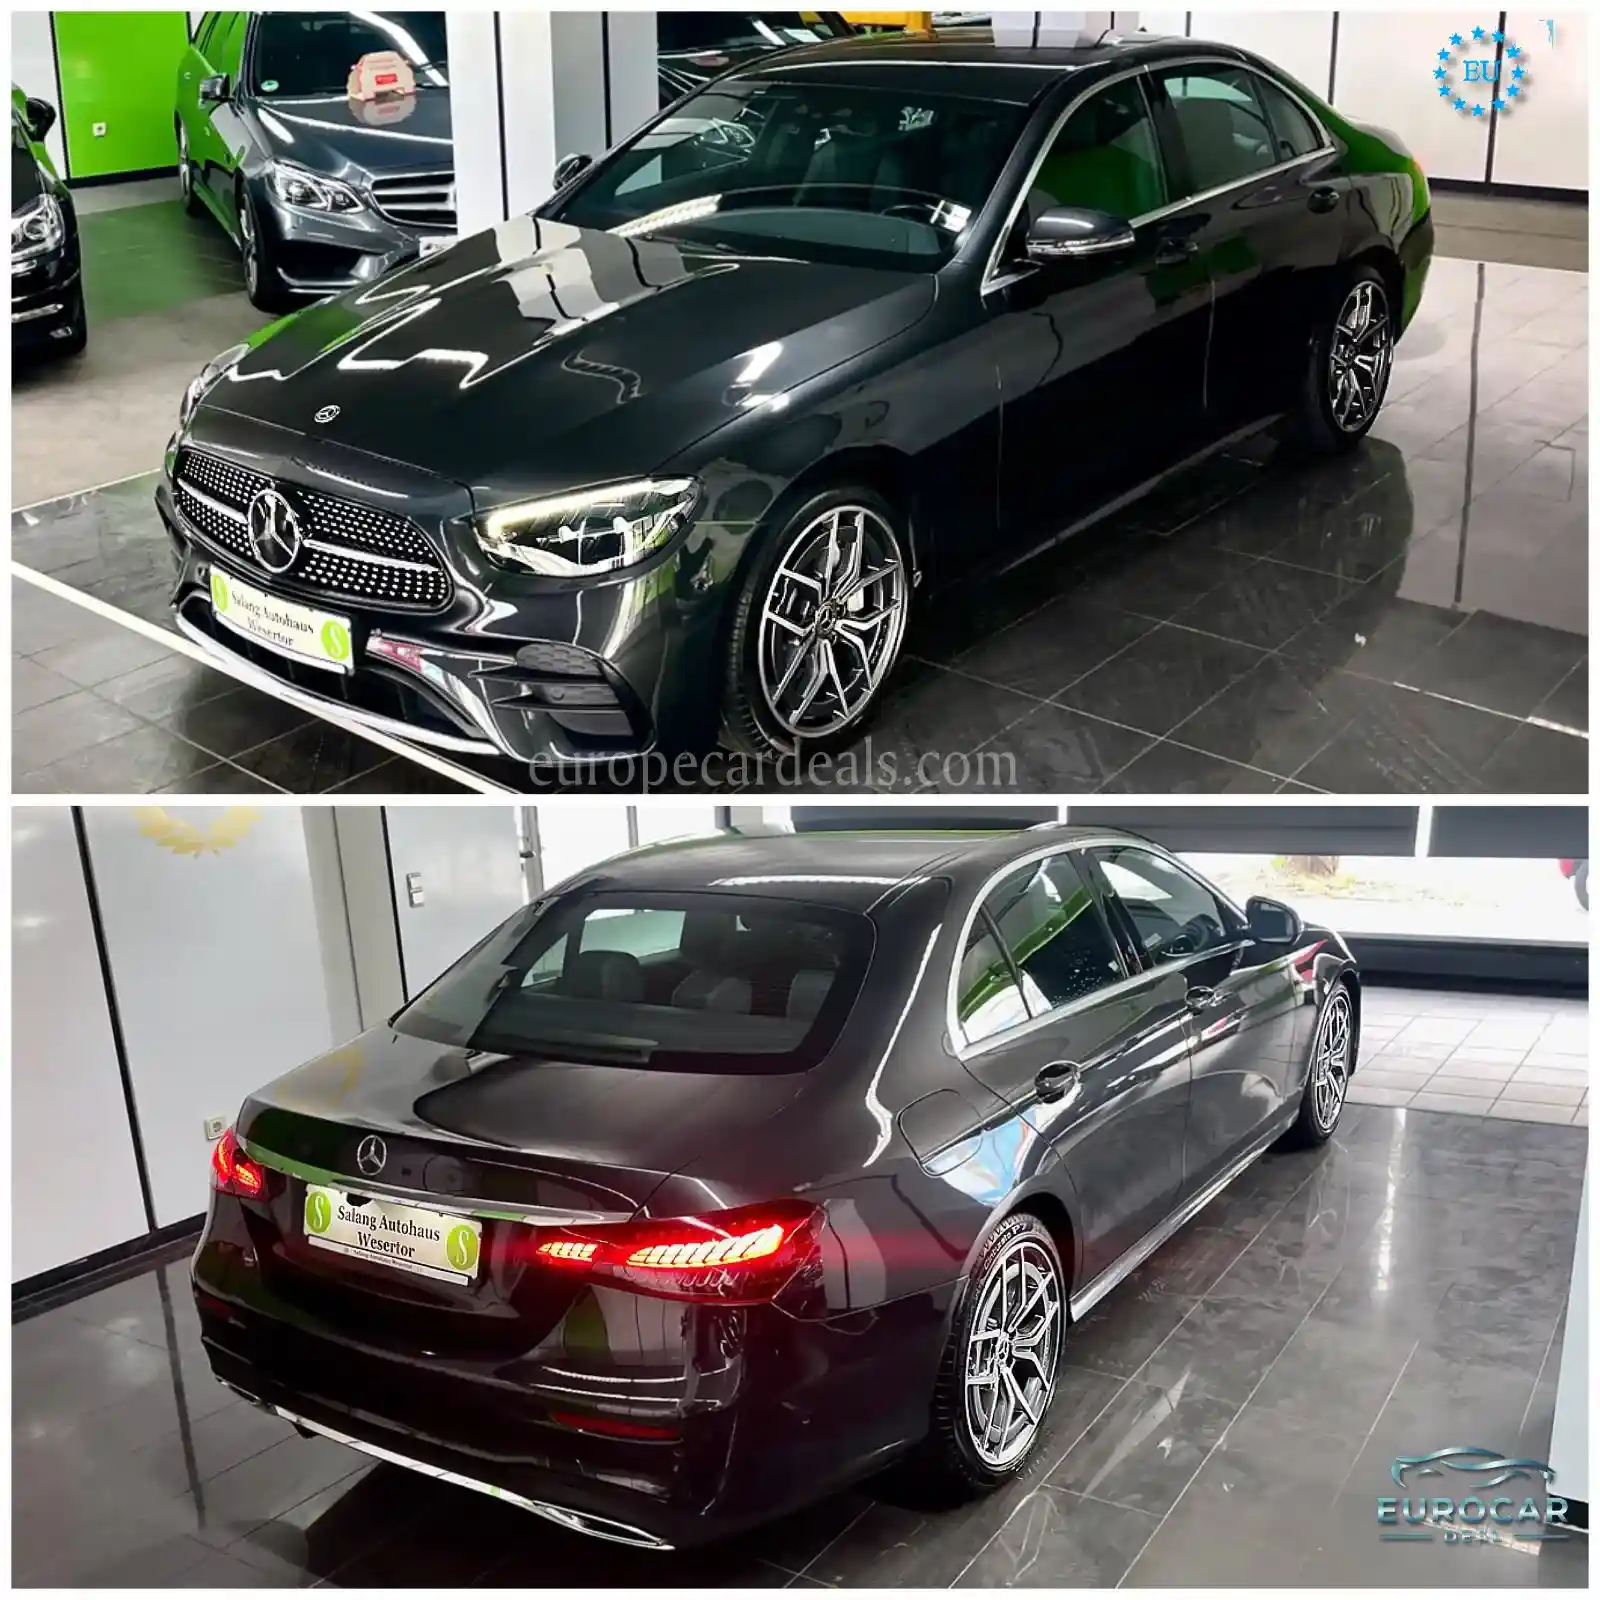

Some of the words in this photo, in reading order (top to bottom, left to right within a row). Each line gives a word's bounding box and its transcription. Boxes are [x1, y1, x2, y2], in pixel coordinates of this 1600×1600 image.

[264, 606, 314, 634] Autohaus
[313, 1196, 325, 1229] S
[337, 1205, 376, 1231] Salang
[379, 1215, 441, 1242] Autohaus
[358, 1231, 416, 1258] Wesertor
[456, 1230, 470, 1266] S
